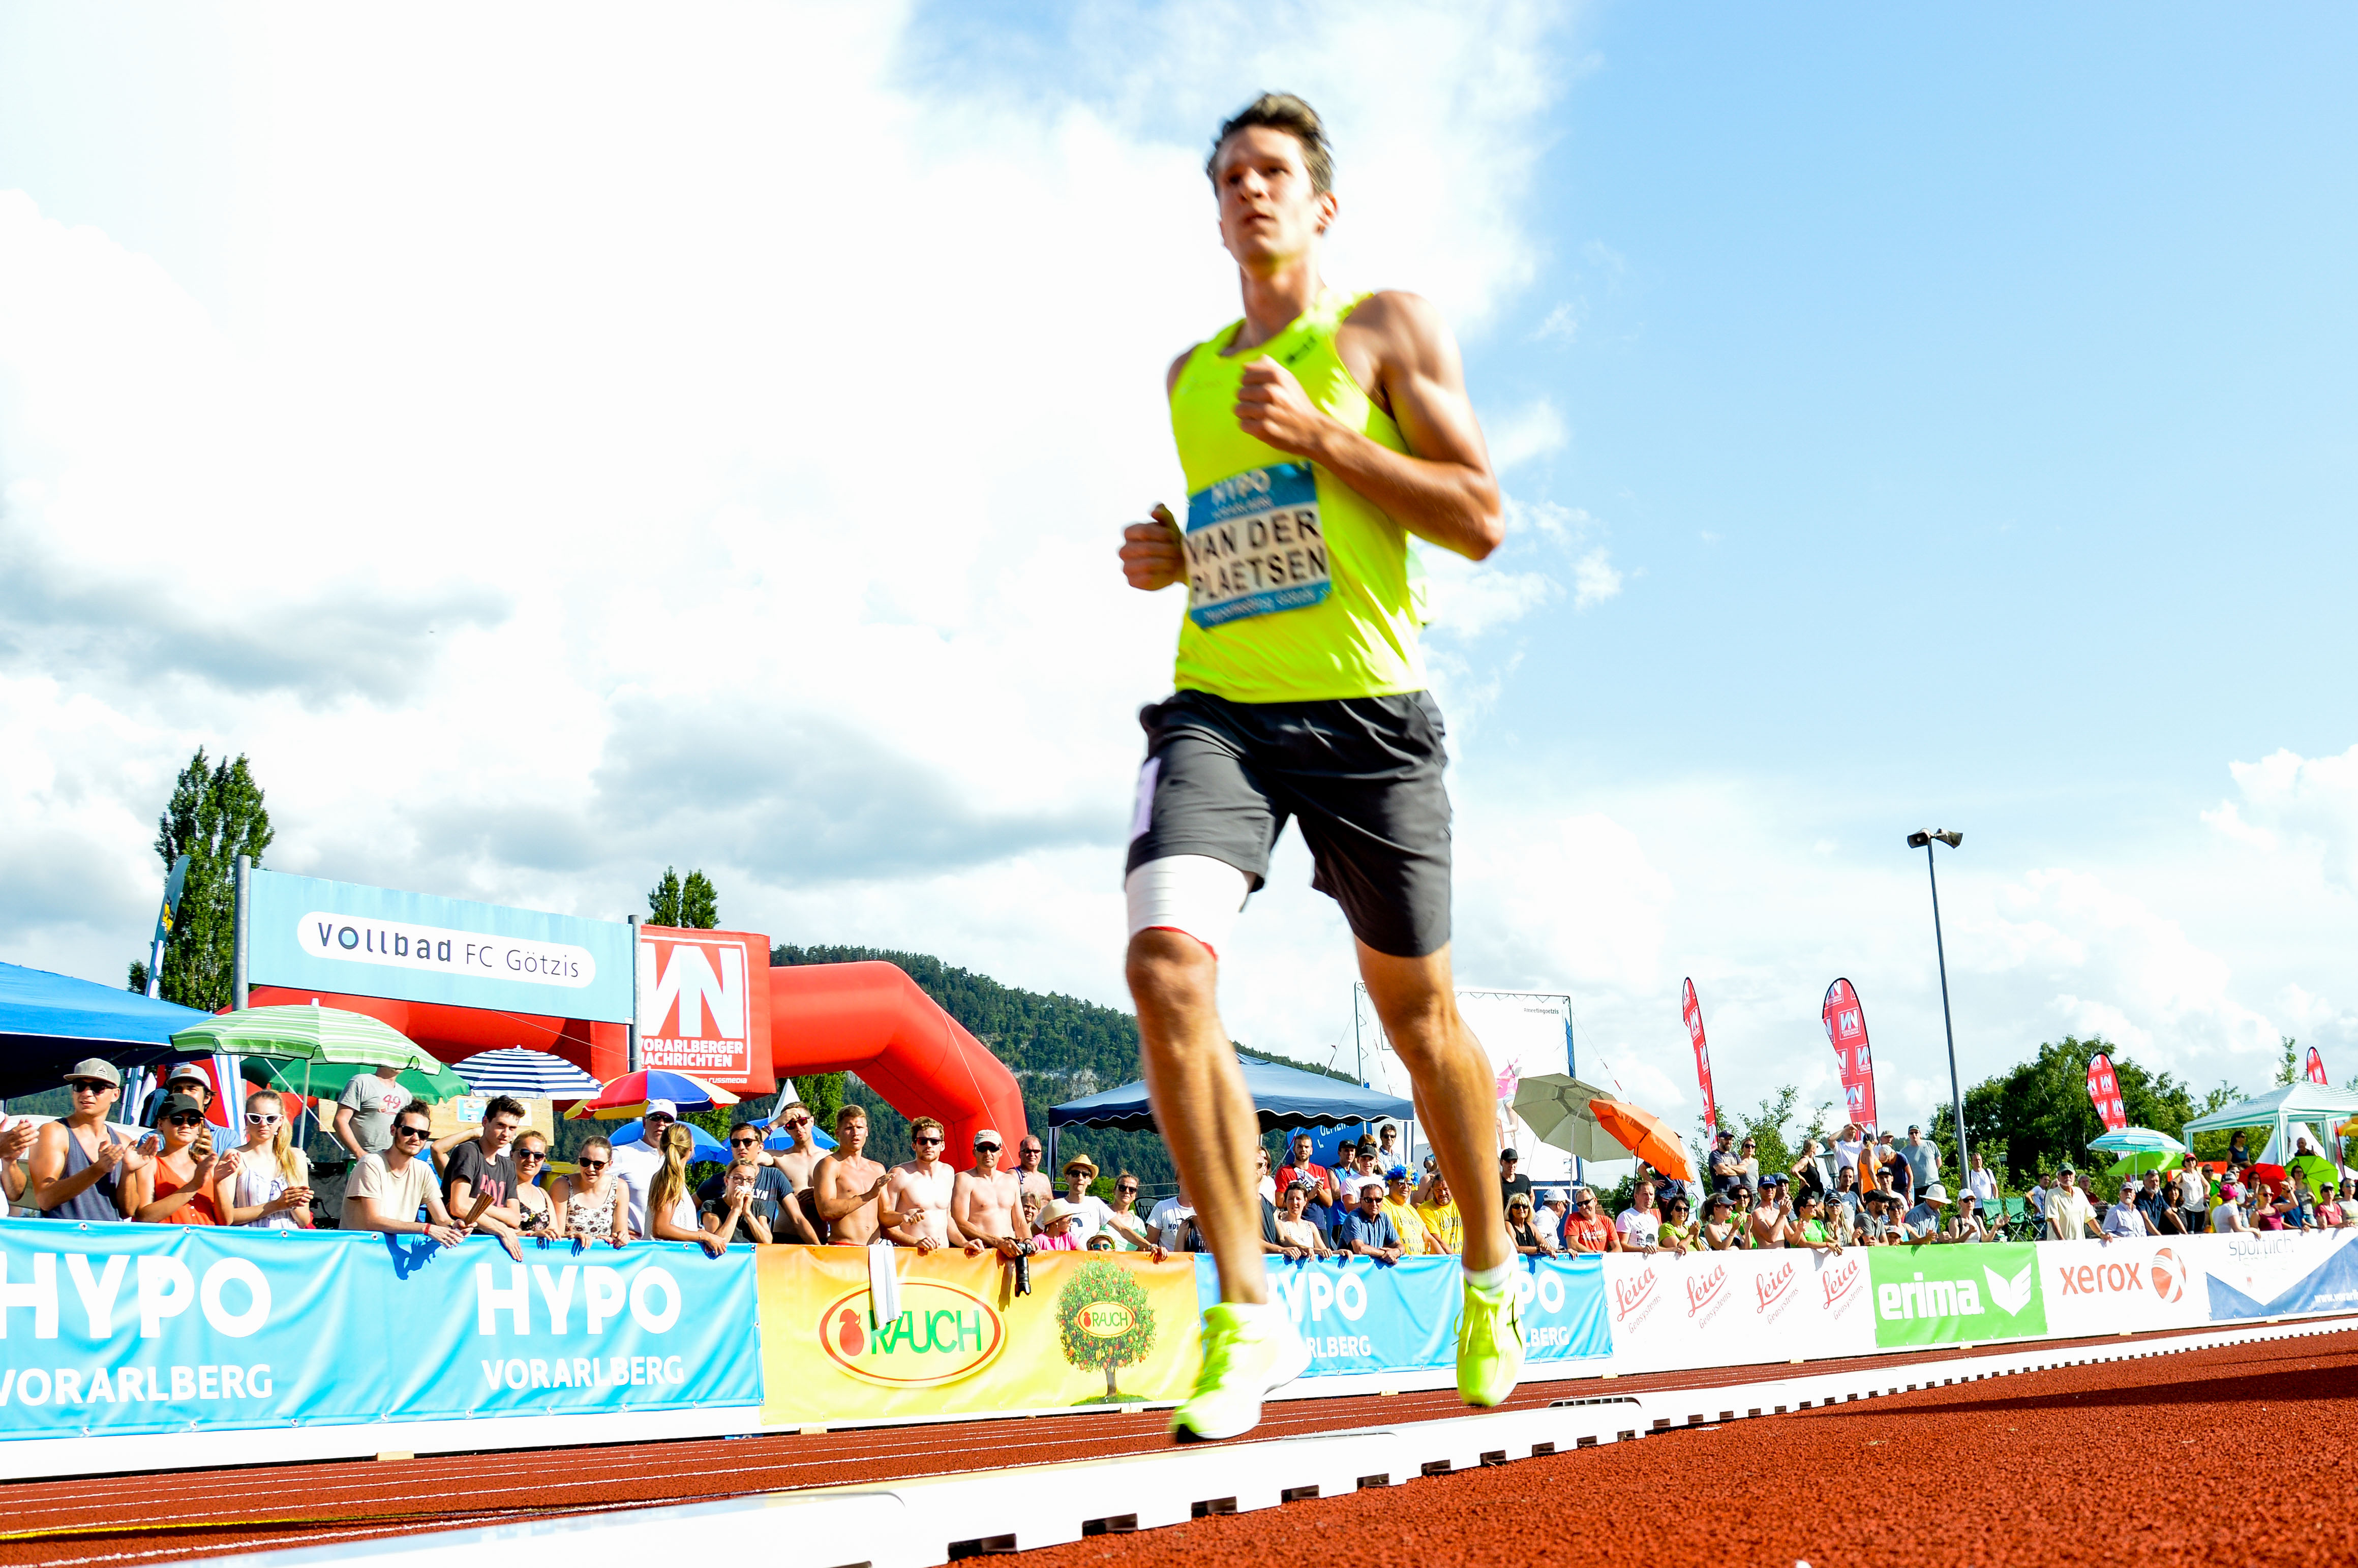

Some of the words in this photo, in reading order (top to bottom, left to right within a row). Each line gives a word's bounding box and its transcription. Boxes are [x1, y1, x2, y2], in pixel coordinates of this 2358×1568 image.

[1184, 524, 1237, 566] VAN
[1247, 509, 1321, 550] DER
[1192, 546, 1326, 605] PLAETSEN
[466, 943, 493, 968] FC
[506, 949, 579, 978] Götzis
[0, 1251, 271, 1338] HYPO
[1616, 1267, 1657, 1322] Leica
[1687, 1264, 1728, 1318] Leica
[1757, 1261, 1796, 1314] Leica
[1823, 1259, 1860, 1310] Leica
[2060, 1262, 2143, 1295] xerox
[475, 1263, 682, 1335] HYPO
[1628, 1295, 1661, 1334] Geosystems
[1699, 1290, 1732, 1329] Geosystems
[1767, 1287, 1799, 1324] Geosystems
[1833, 1284, 1863, 1320] Geosystems
[1092, 1312, 1128, 1326] RAUCH
[1306, 1335, 1371, 1358] RLBERG
[481, 1355, 685, 1390] VORARLBERG
